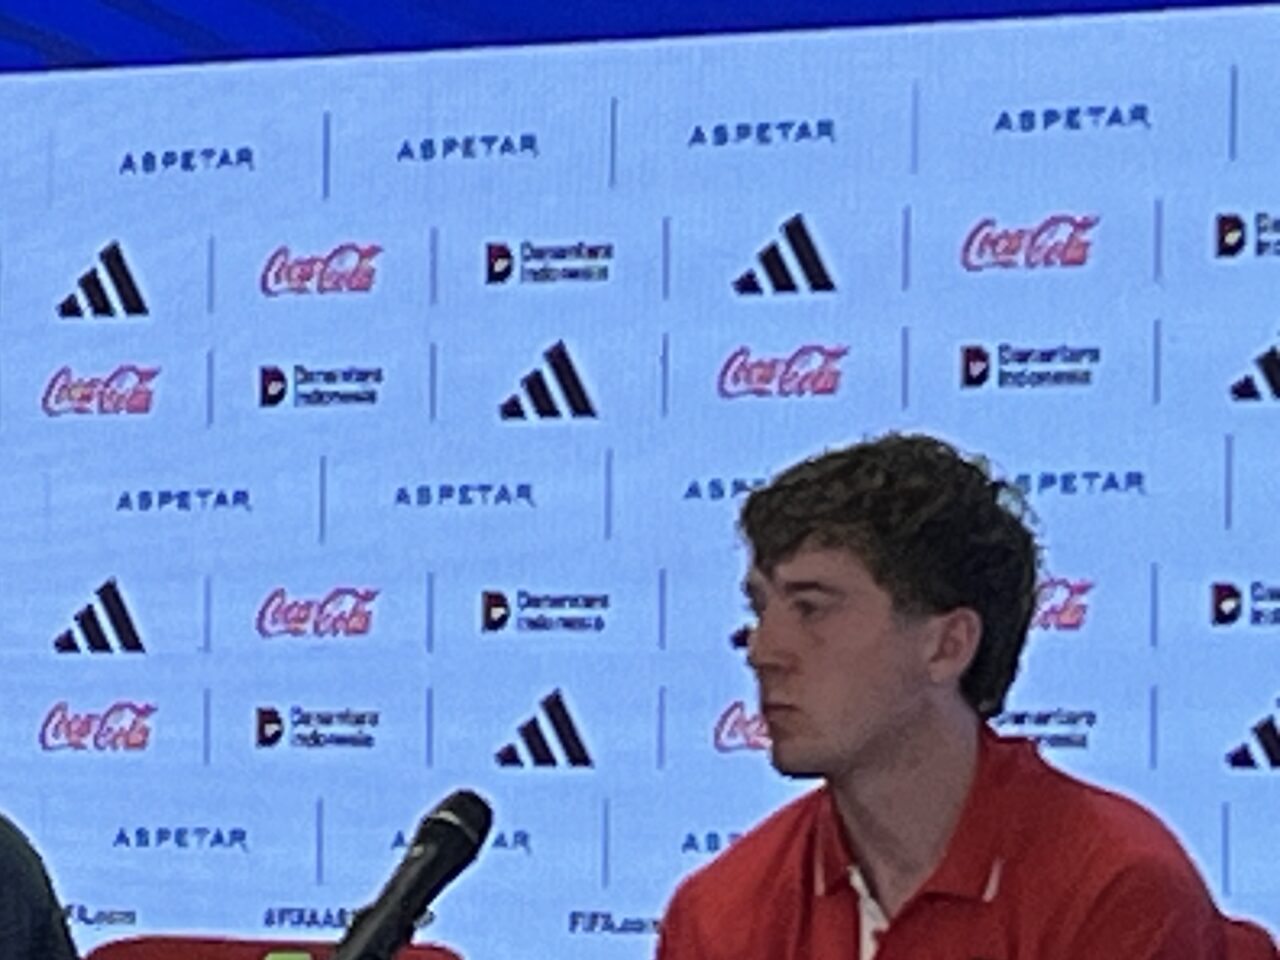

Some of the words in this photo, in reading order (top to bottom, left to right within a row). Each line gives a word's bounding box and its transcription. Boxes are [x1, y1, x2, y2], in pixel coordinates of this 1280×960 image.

[994, 104, 1151, 132] ASPETAR
[688, 119, 835, 147] ASPETAR
[119, 147, 254, 174] ASPETAR
[397, 134, 539, 161] ASPETAR
[395, 484, 536, 507] ASPETAR
[1015, 471, 1148, 496] SPETAR
[116, 489, 252, 511] ASPETAR
[113, 827, 246, 851] ASPETAR
